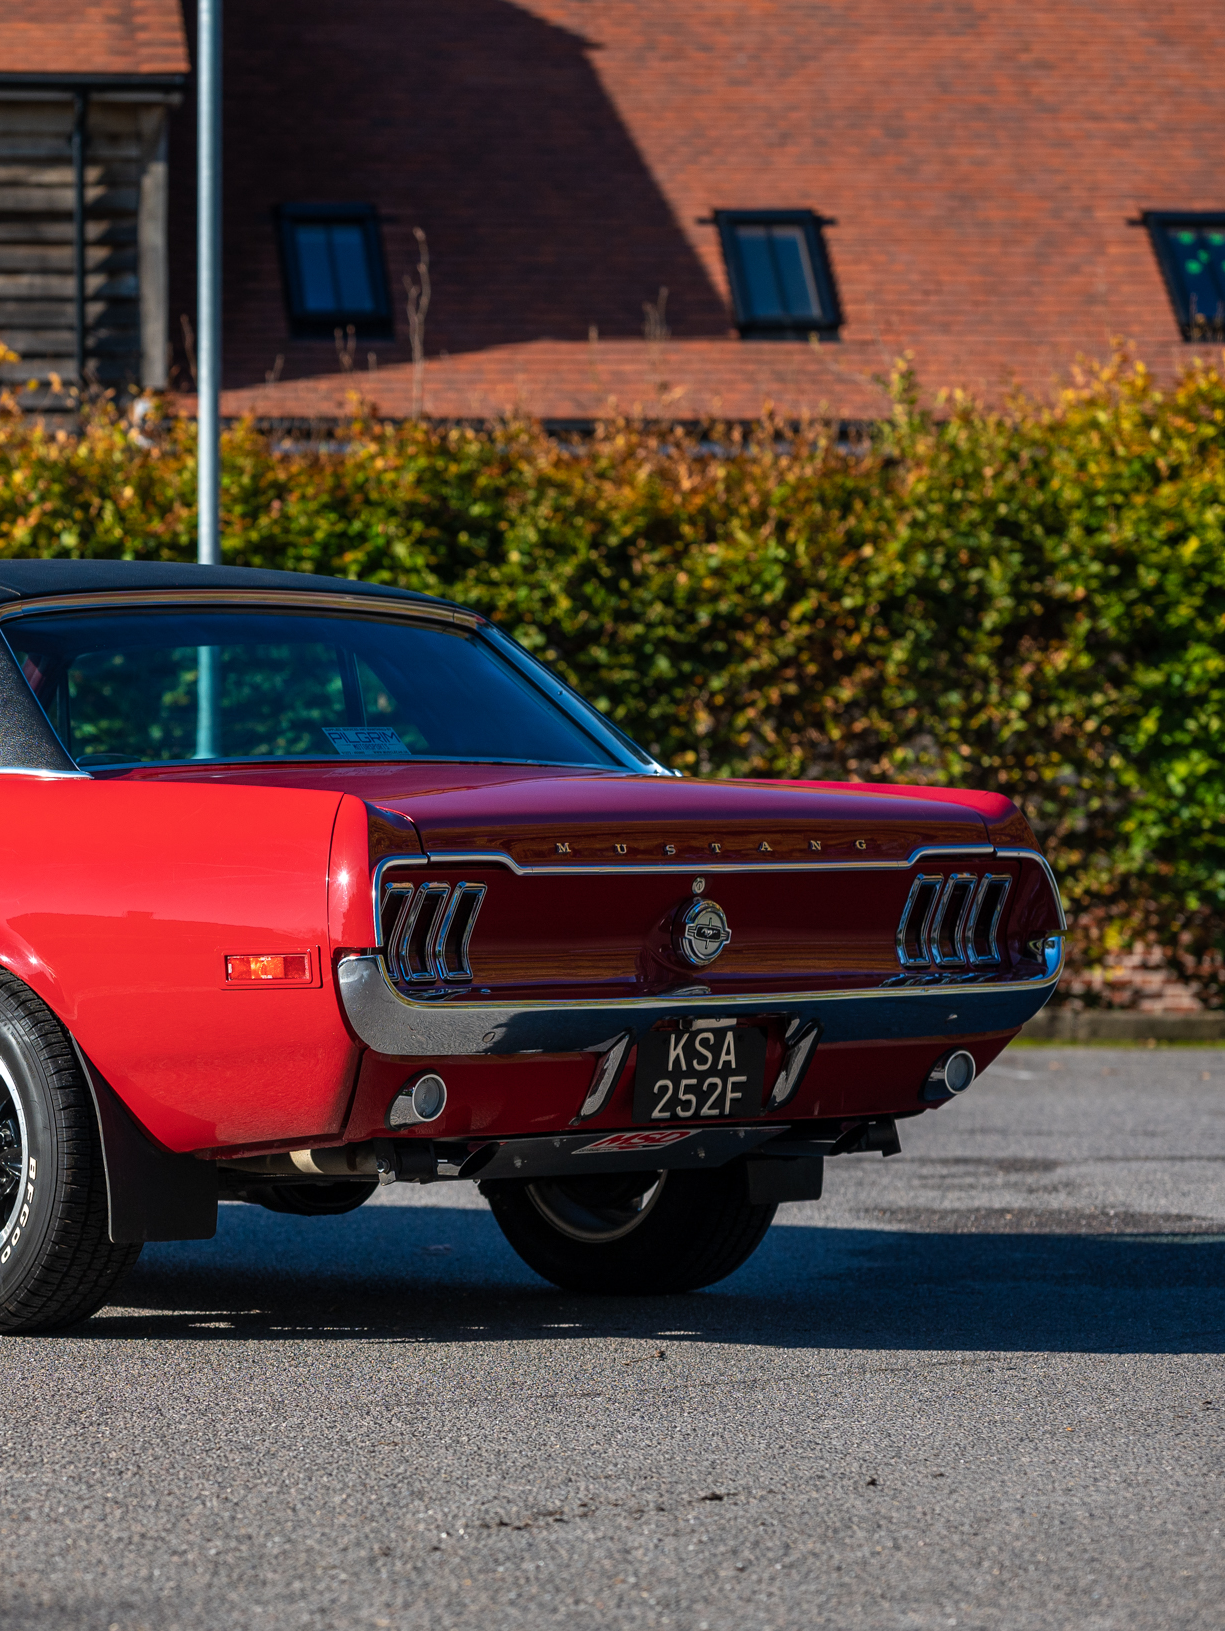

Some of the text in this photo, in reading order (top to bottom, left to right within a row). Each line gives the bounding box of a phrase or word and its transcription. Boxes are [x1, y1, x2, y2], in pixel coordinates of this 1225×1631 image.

[327, 731, 401, 743] PILGRIM
[557, 840, 867, 855] MUSTANG
[668, 1031, 736, 1072] KSA
[652, 1075, 748, 1119] 252F
[590, 1131, 692, 1148] MSD
